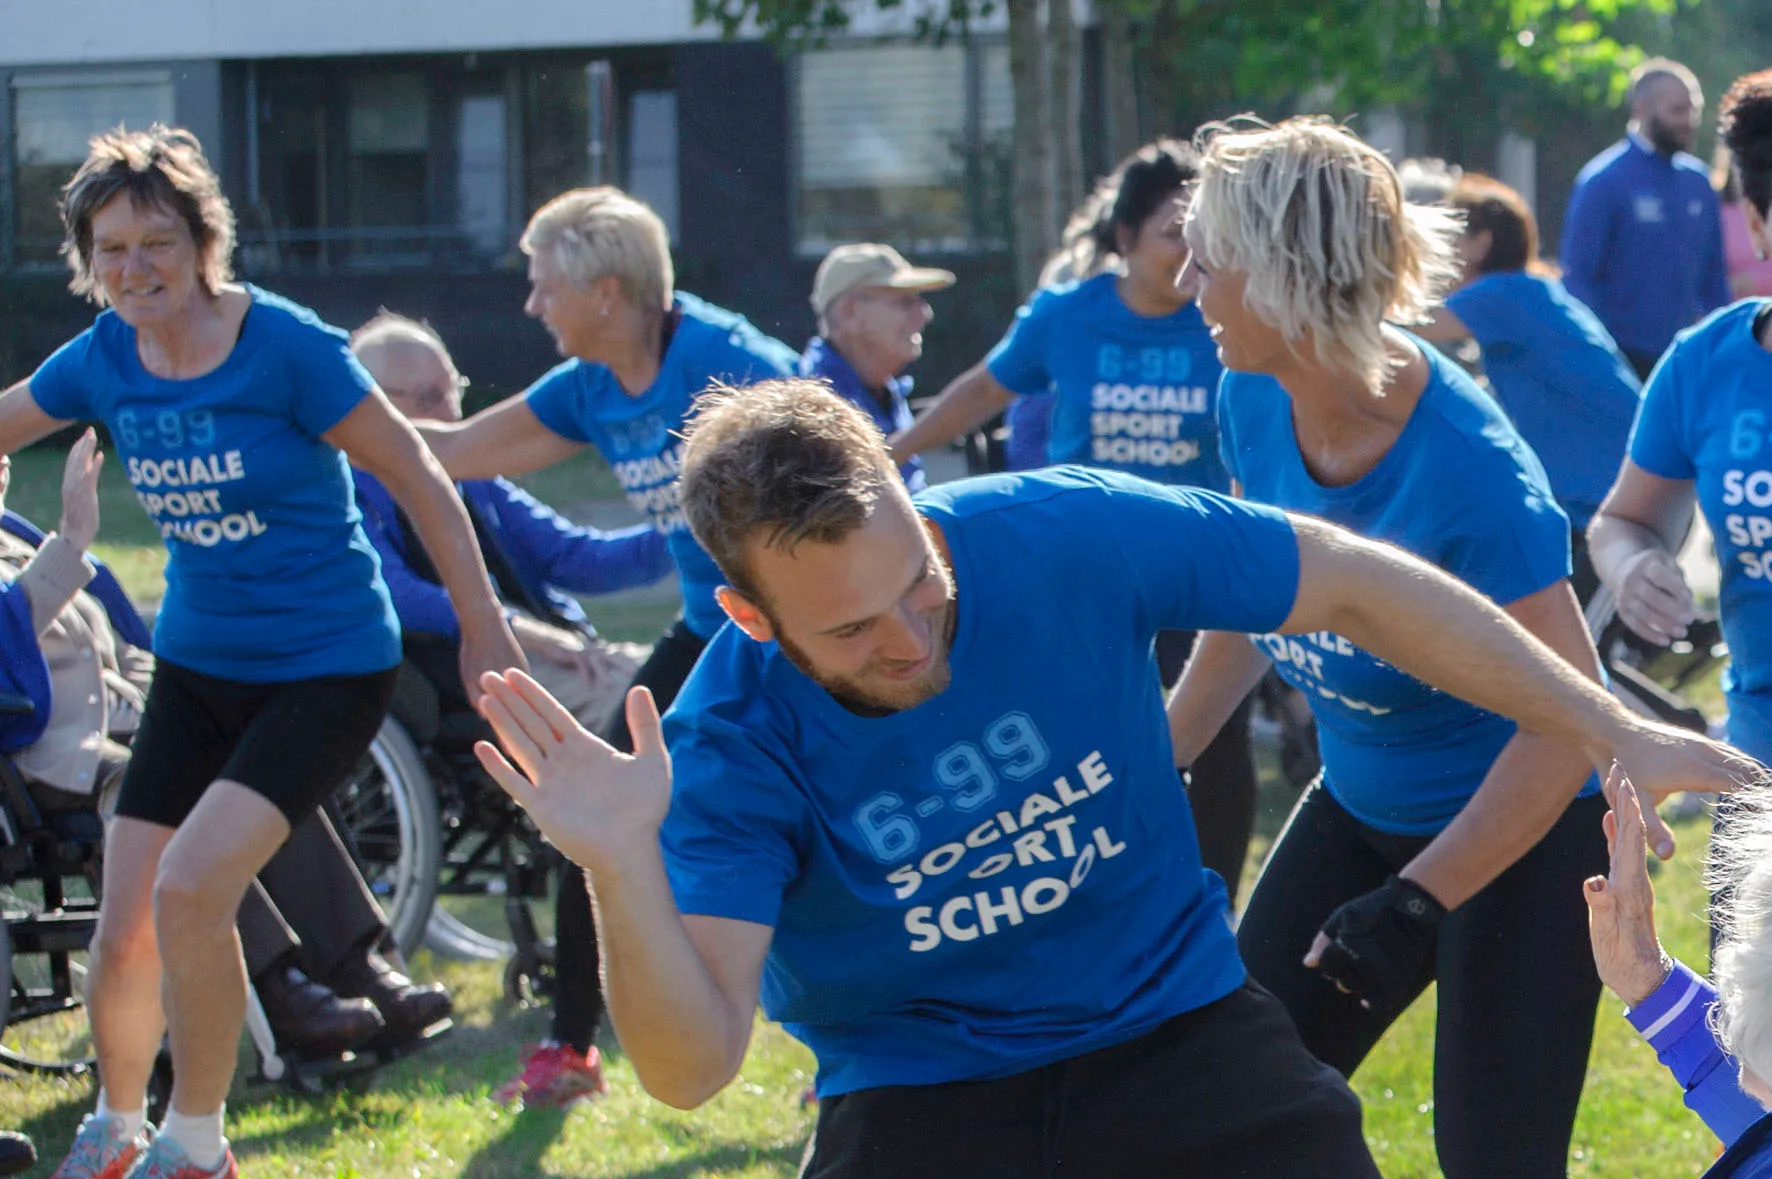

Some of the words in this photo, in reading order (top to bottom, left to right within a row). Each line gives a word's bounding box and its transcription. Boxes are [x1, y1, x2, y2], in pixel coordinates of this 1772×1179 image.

[1097, 344, 1191, 381] 6-99
[1091, 382, 1207, 414] SOCIALE
[116, 410, 216, 450] 6-99
[1091, 411, 1184, 440] SPORT
[128, 449, 245, 487] SOCIALE
[852, 710, 1051, 865] 6-99
[885, 750, 1114, 900] SOCIALE
[968, 814, 1077, 879] ORT
[904, 826, 1127, 953] SCHOOL
